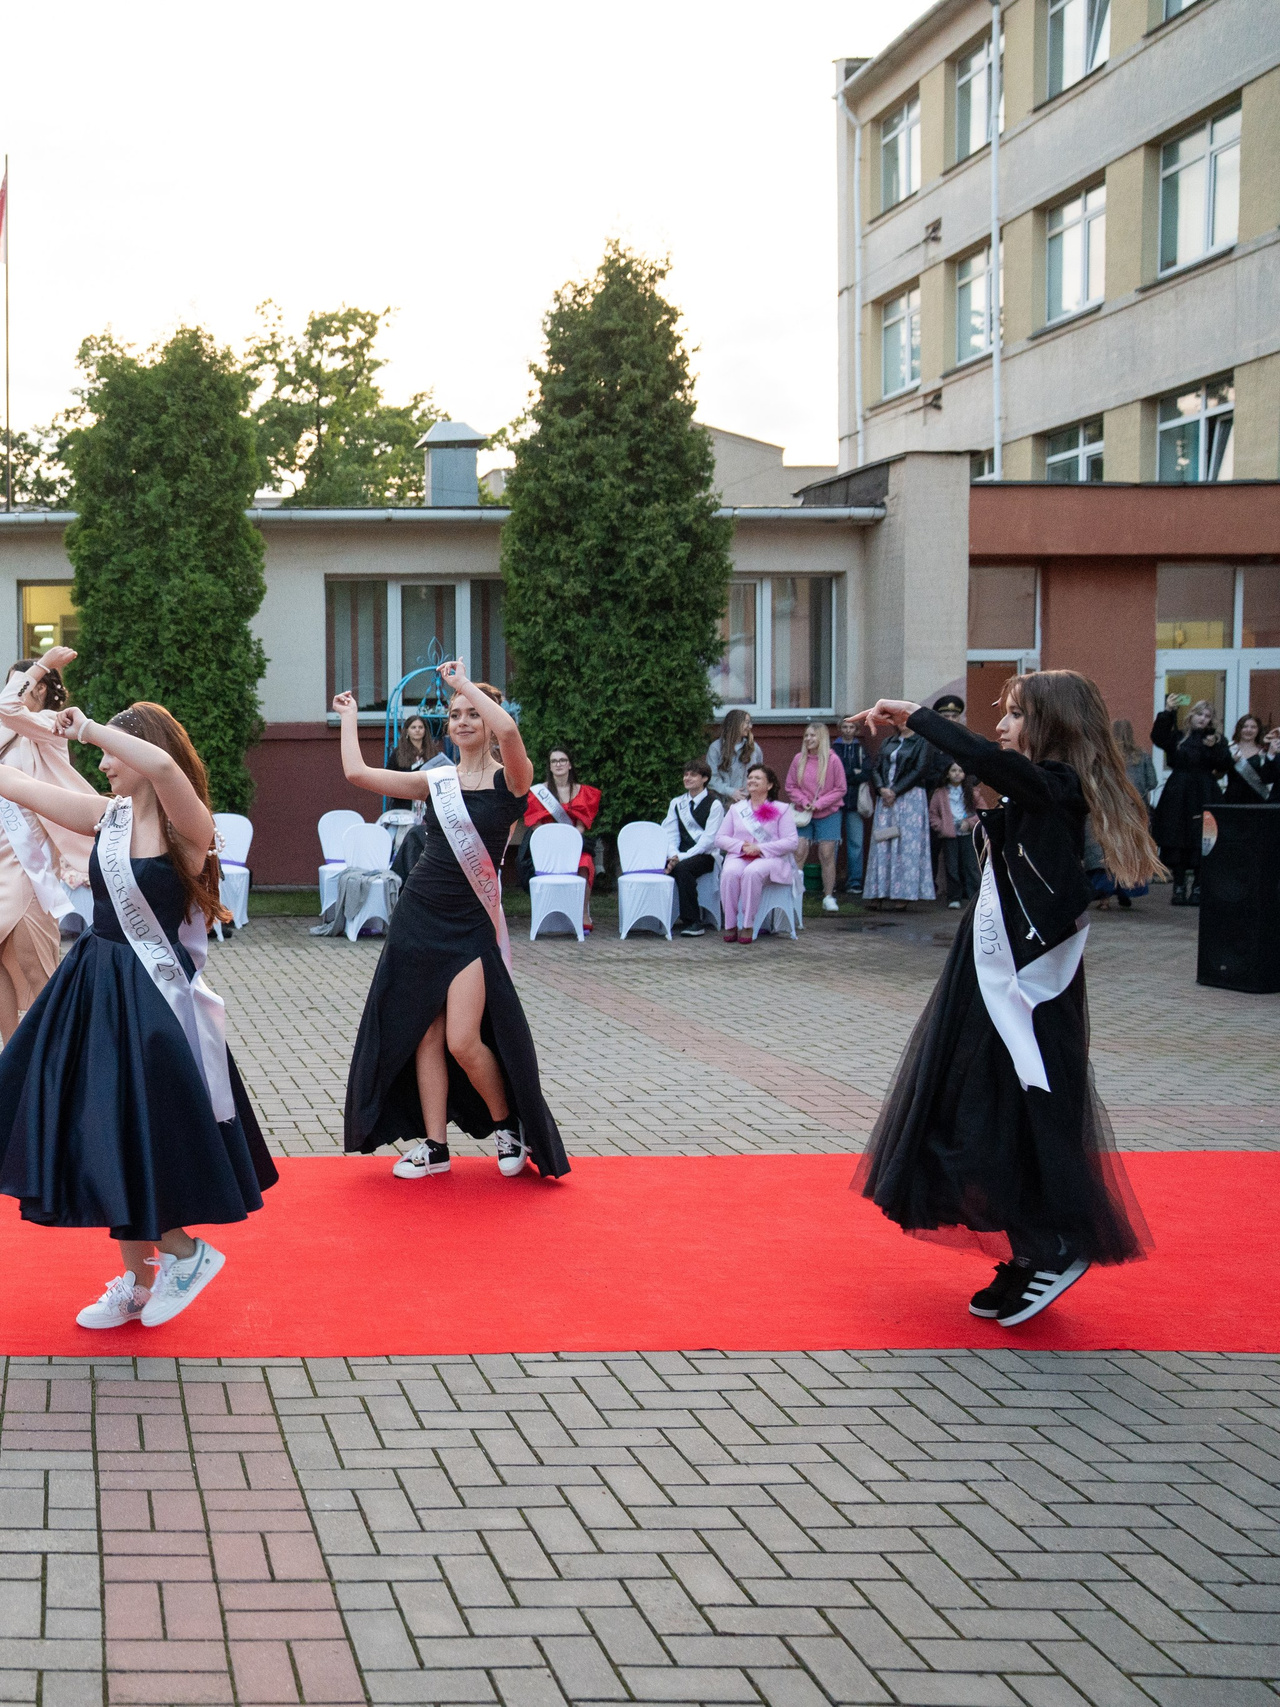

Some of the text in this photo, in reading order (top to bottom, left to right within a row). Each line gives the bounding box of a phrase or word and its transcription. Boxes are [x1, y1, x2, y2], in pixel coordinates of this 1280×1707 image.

[1, 801, 22, 831] 2025
[440, 791, 482, 878] Выпускніца
[104, 827, 150, 938] Выпускніца
[143, 934, 183, 982] 2025
[980, 908, 1002, 955] 2025
